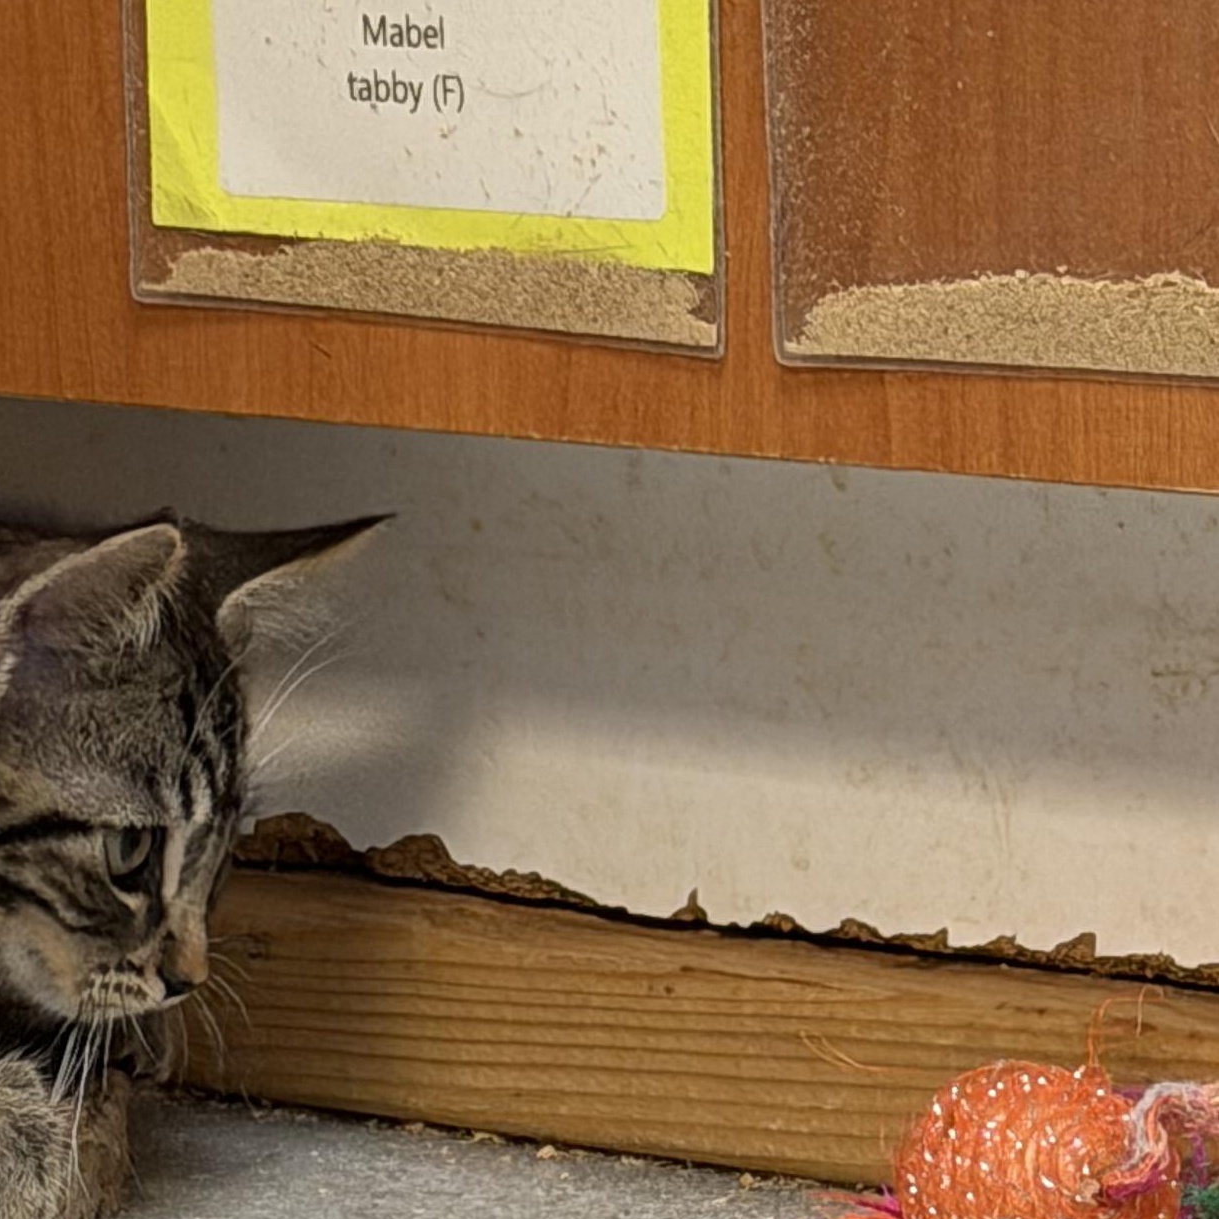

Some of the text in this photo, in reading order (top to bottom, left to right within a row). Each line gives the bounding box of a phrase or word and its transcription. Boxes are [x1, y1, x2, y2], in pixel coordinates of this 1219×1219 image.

[362, 13, 445, 50] Mabel
[347, 68, 465, 114] tabby (F)
